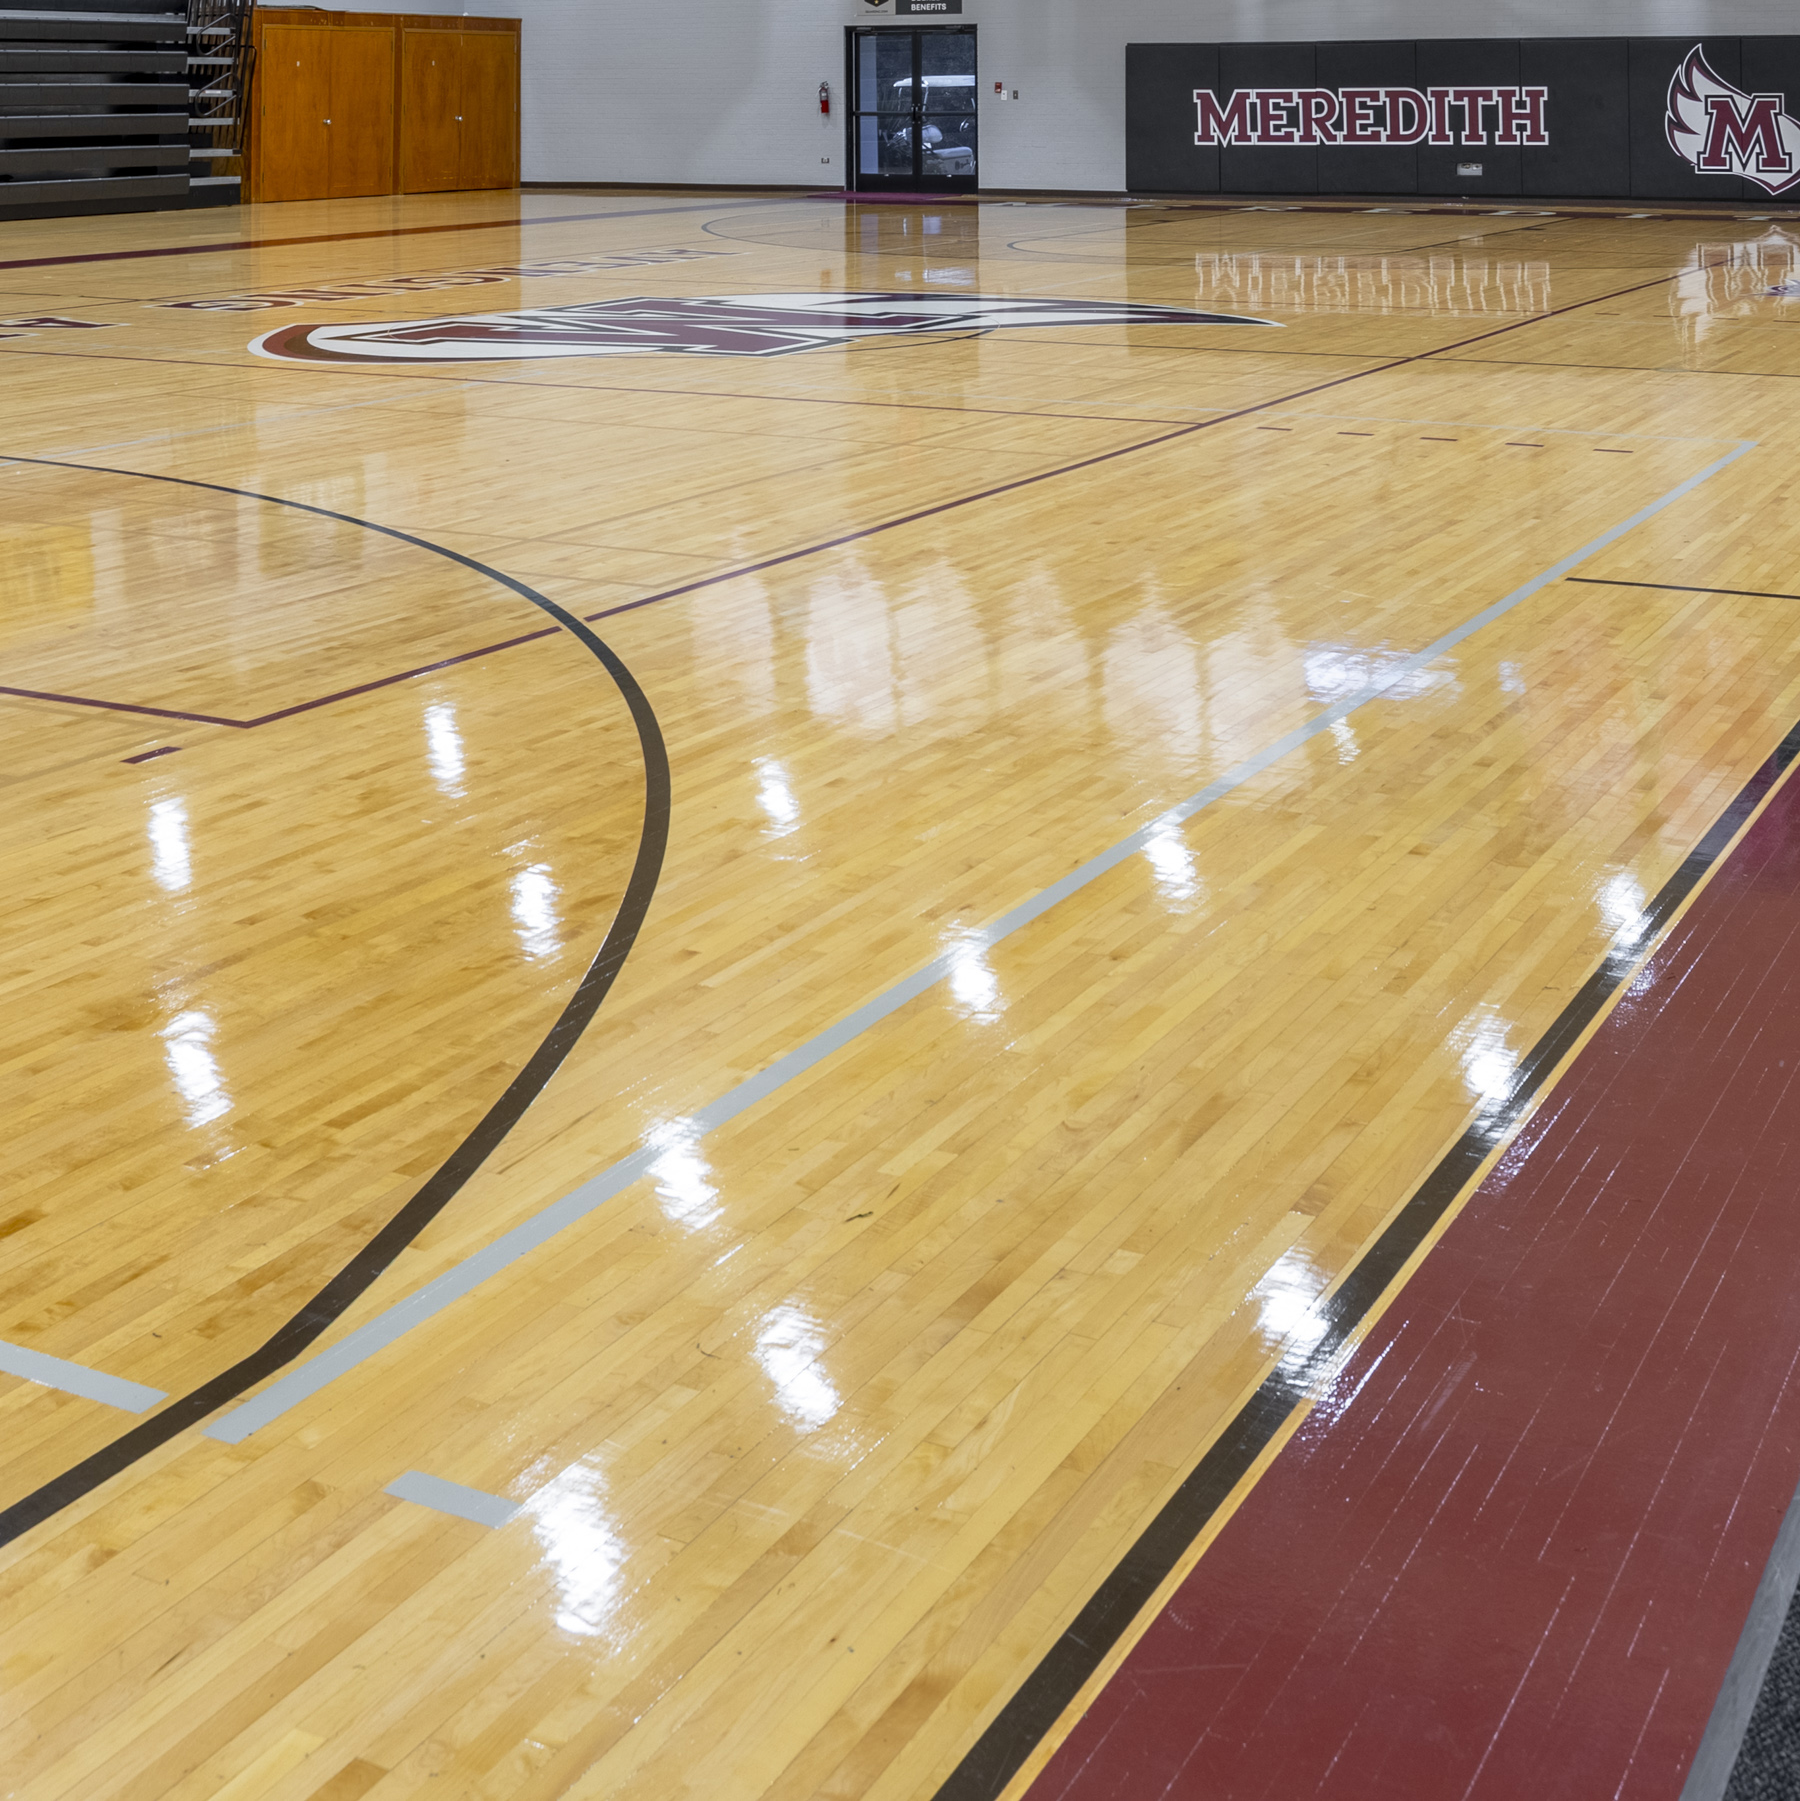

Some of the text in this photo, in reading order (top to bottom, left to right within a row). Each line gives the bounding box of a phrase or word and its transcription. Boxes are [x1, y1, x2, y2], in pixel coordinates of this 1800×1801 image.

[910, 3, 947, 11] BENEFITS
[1192, 85, 1550, 147] MEREDITH
[1695, 93, 1793, 173] M
[142, 249, 750, 312] AVENGING
